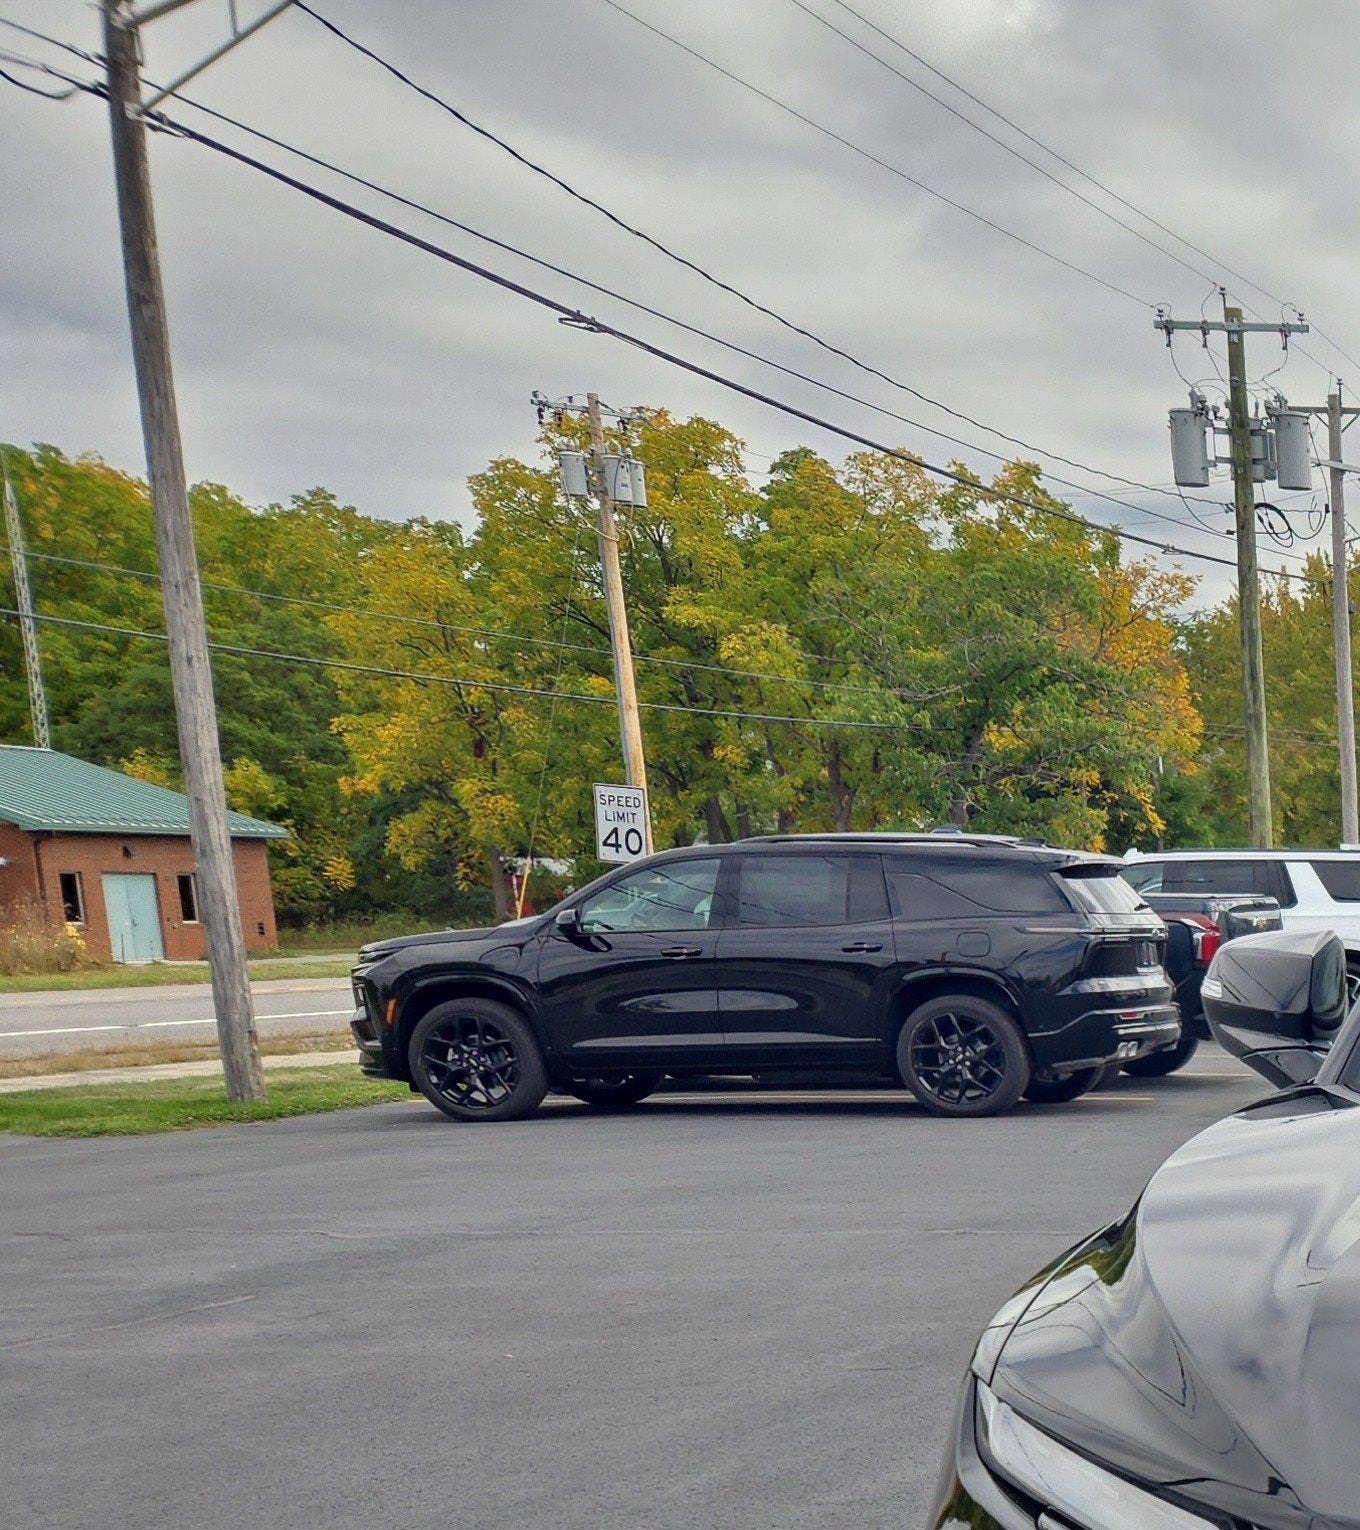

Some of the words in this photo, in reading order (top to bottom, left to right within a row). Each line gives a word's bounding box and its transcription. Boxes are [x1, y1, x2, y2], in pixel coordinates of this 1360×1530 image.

[599, 794, 641, 808] SPEED
[604, 811, 637, 824] LIMIT
[602, 827, 643, 855] 40
